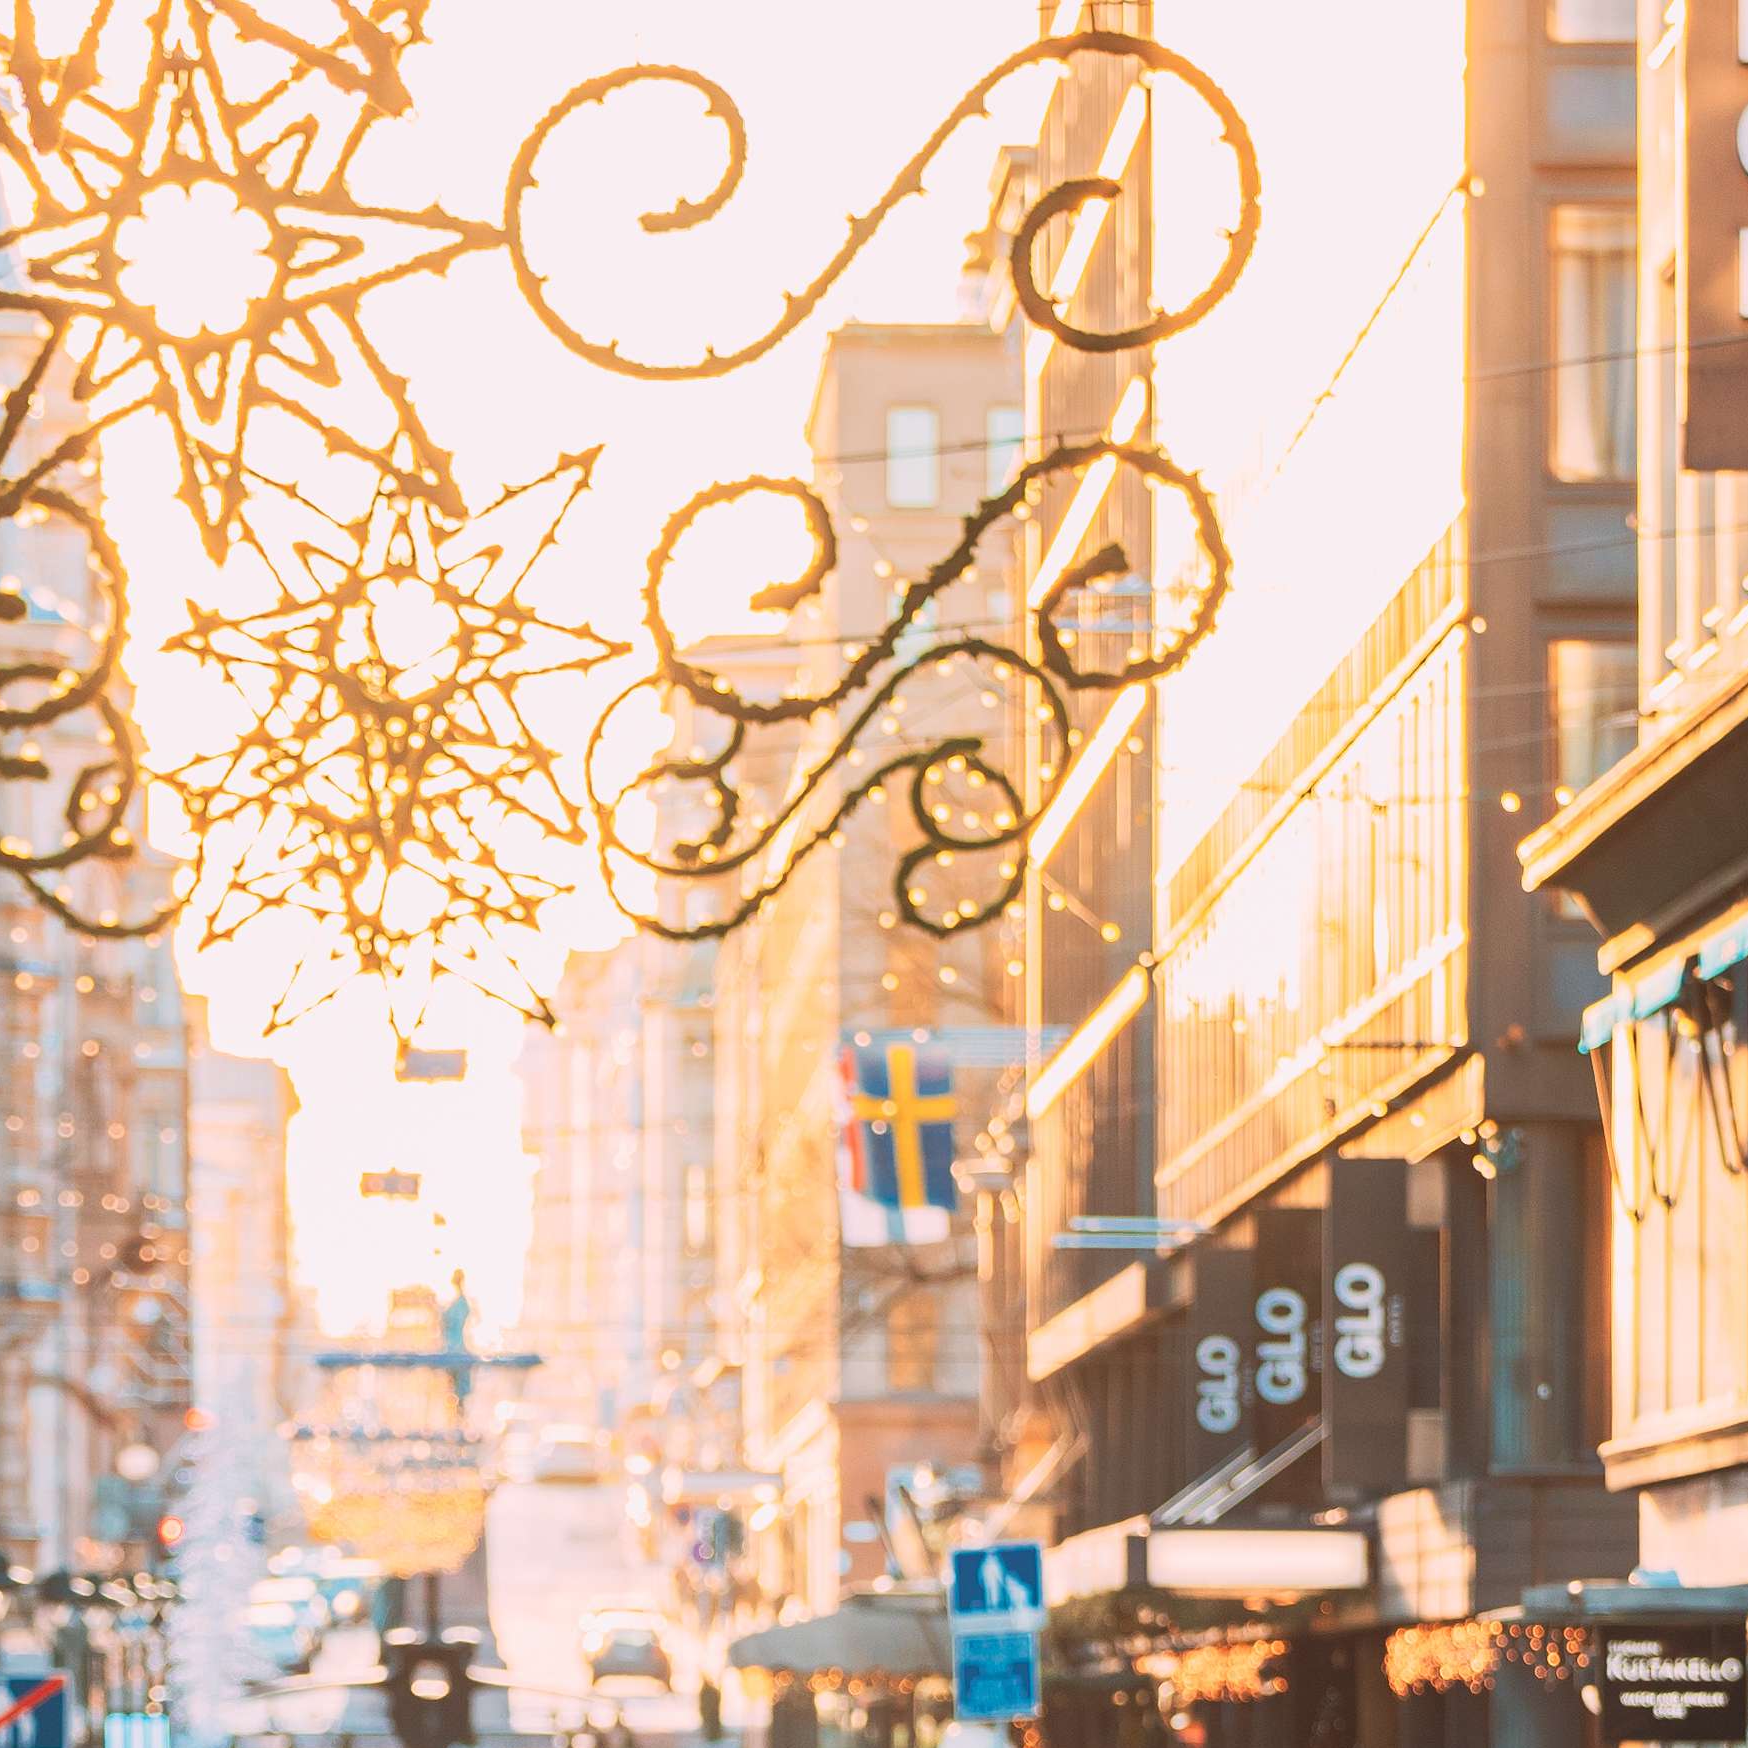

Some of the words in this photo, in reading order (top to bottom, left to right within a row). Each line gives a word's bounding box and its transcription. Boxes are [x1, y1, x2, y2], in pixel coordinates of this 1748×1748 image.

[1255, 1287, 1307, 1405] GLO
[1334, 1262, 1386, 1379] GLO
[1195, 1334, 1240, 1434] GLO
